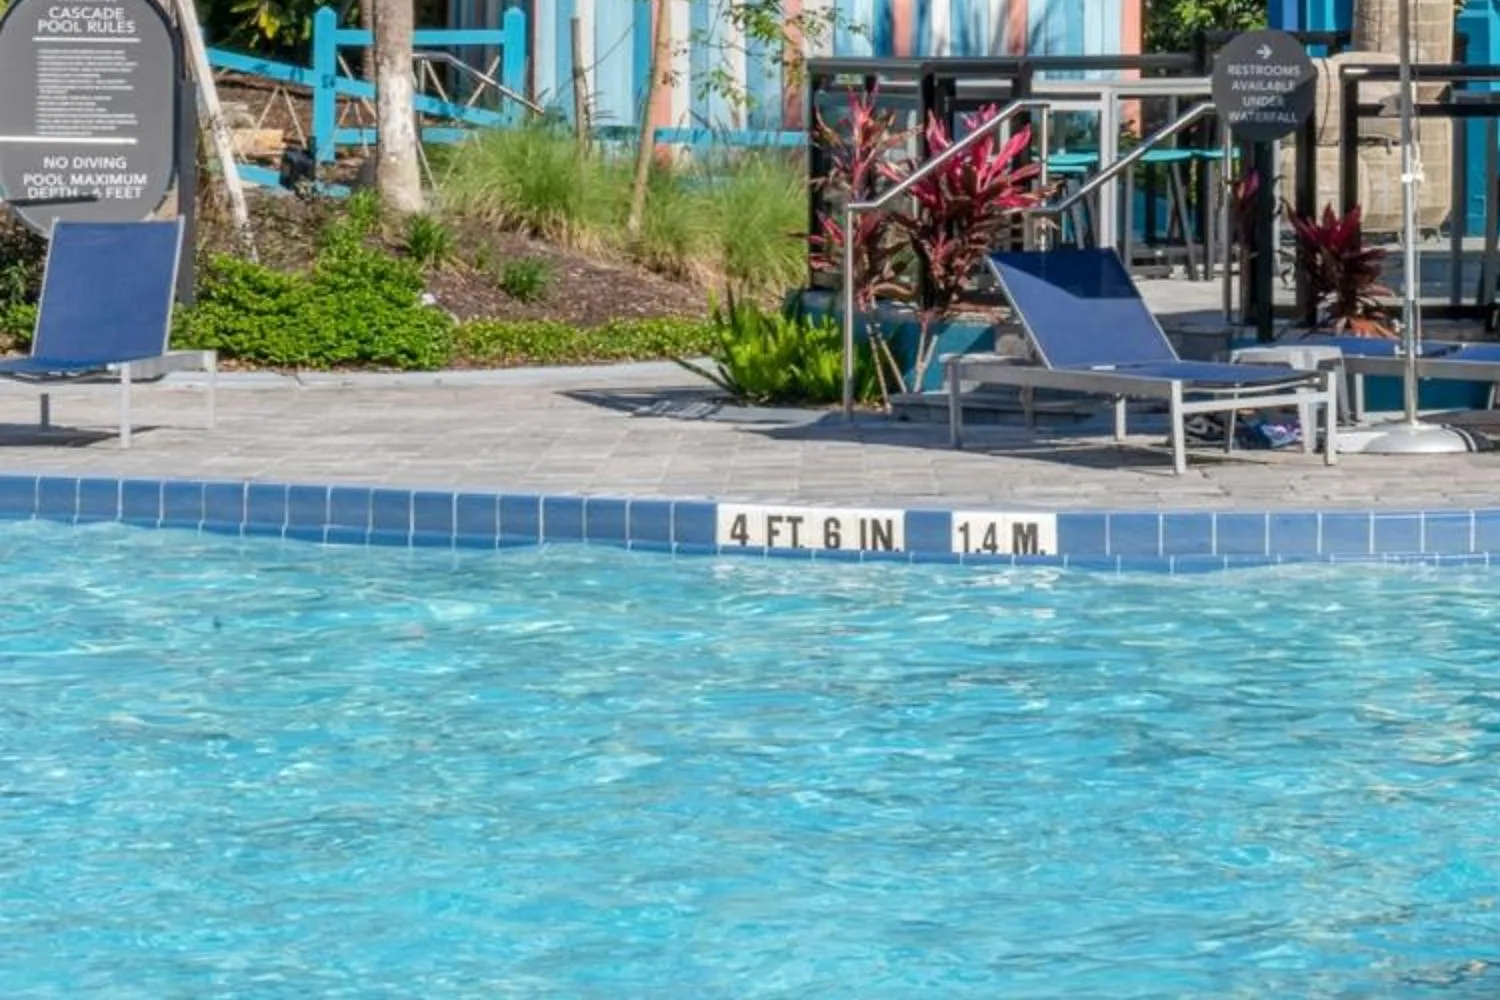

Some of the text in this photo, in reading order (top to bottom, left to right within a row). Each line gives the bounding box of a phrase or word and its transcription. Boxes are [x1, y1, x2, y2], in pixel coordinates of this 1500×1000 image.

[49, 6, 125, 20] CASCADE
[37, 19, 136, 34] POOL RULES
[1228, 64, 1300, 76] RESTROOMS
[1231, 80, 1296, 92] AVAILABLE
[1242, 96, 1284, 107] UNDER
[43, 156, 127, 169] NO DIVING
[23, 173, 147, 186] POOL MAXIMUM
[27, 186, 78, 199] DEPTH
[105, 186, 143, 199] FEET
[730, 514, 749, 547] 4
[823, 517, 841, 549] 6
[958, 521, 999, 554] 1.4
